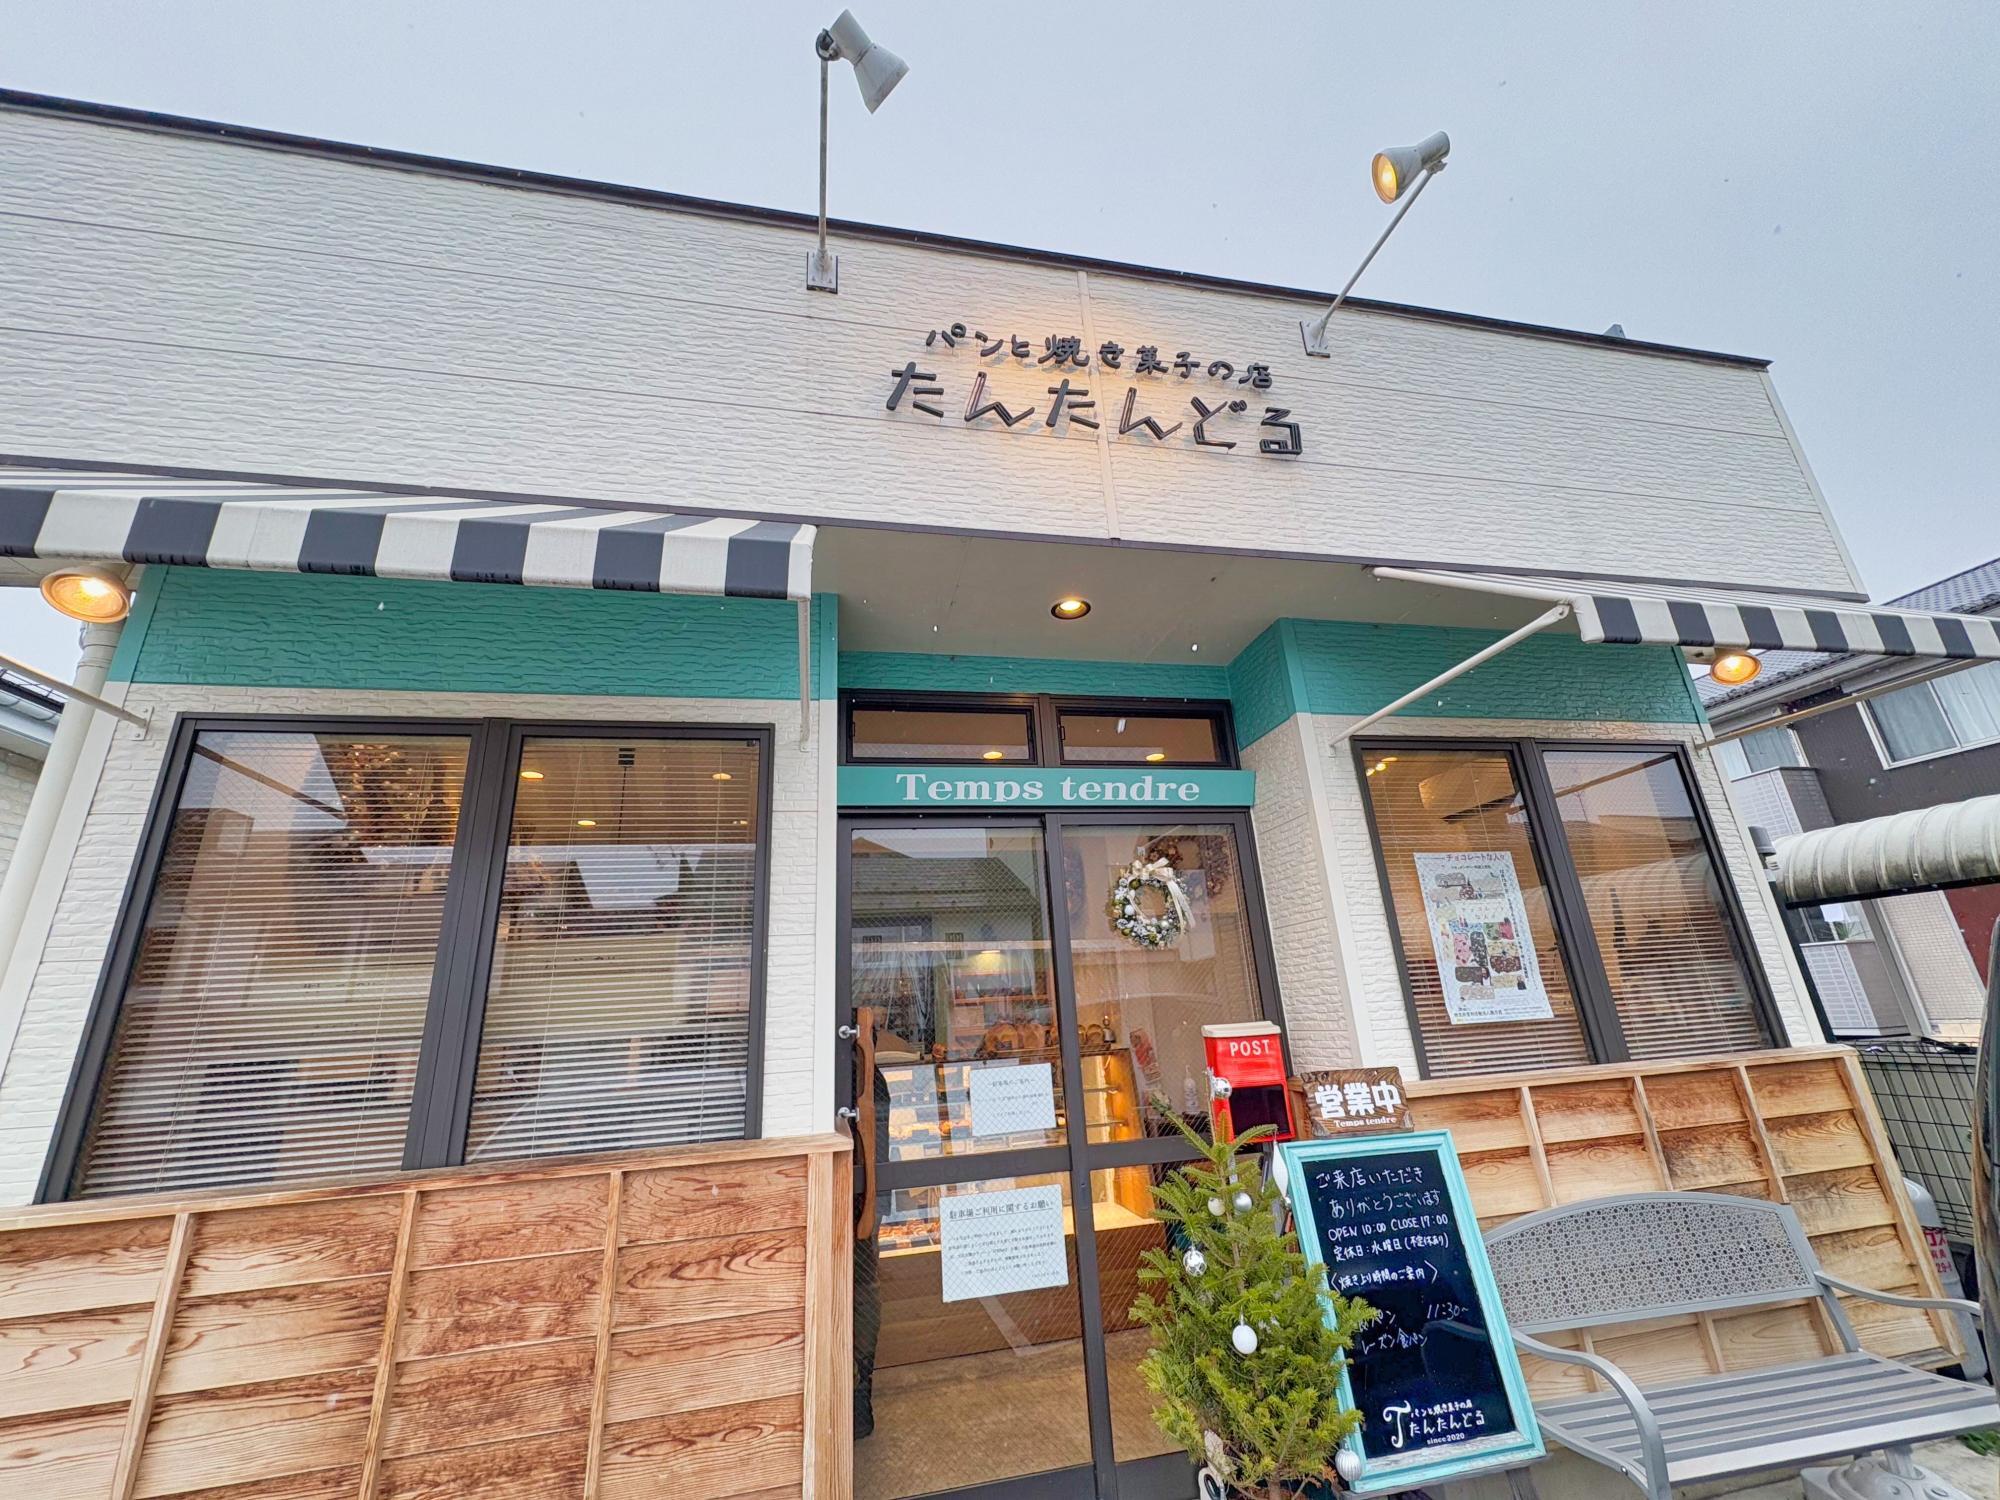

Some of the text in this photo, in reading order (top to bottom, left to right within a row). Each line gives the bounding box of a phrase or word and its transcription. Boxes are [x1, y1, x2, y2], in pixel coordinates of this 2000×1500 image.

[926, 323, 1273, 389] パンと焼き菓子の店
[886, 362, 1303, 455] たんたんどる
[896, 773, 1200, 803] Temps tendre
[1229, 1039, 1270, 1057] POST
[1315, 1081, 1401, 1119] 営業中
[1334, 1116, 1397, 1128] Temps tendre
[1316, 1167, 1423, 1190] ご来店いただき
[949, 1199, 1054, 1219] 駐車場ご利用に関するお願い
[1329, 1189, 1441, 1219] ありがとうございます
[1328, 1213, 1449, 1242] OPEN 10:00 CLOSE 17:00
[1362, 1327, 1428, 1355] レーズン食パン
[1409, 1410, 1485, 1437] たんたんどる
